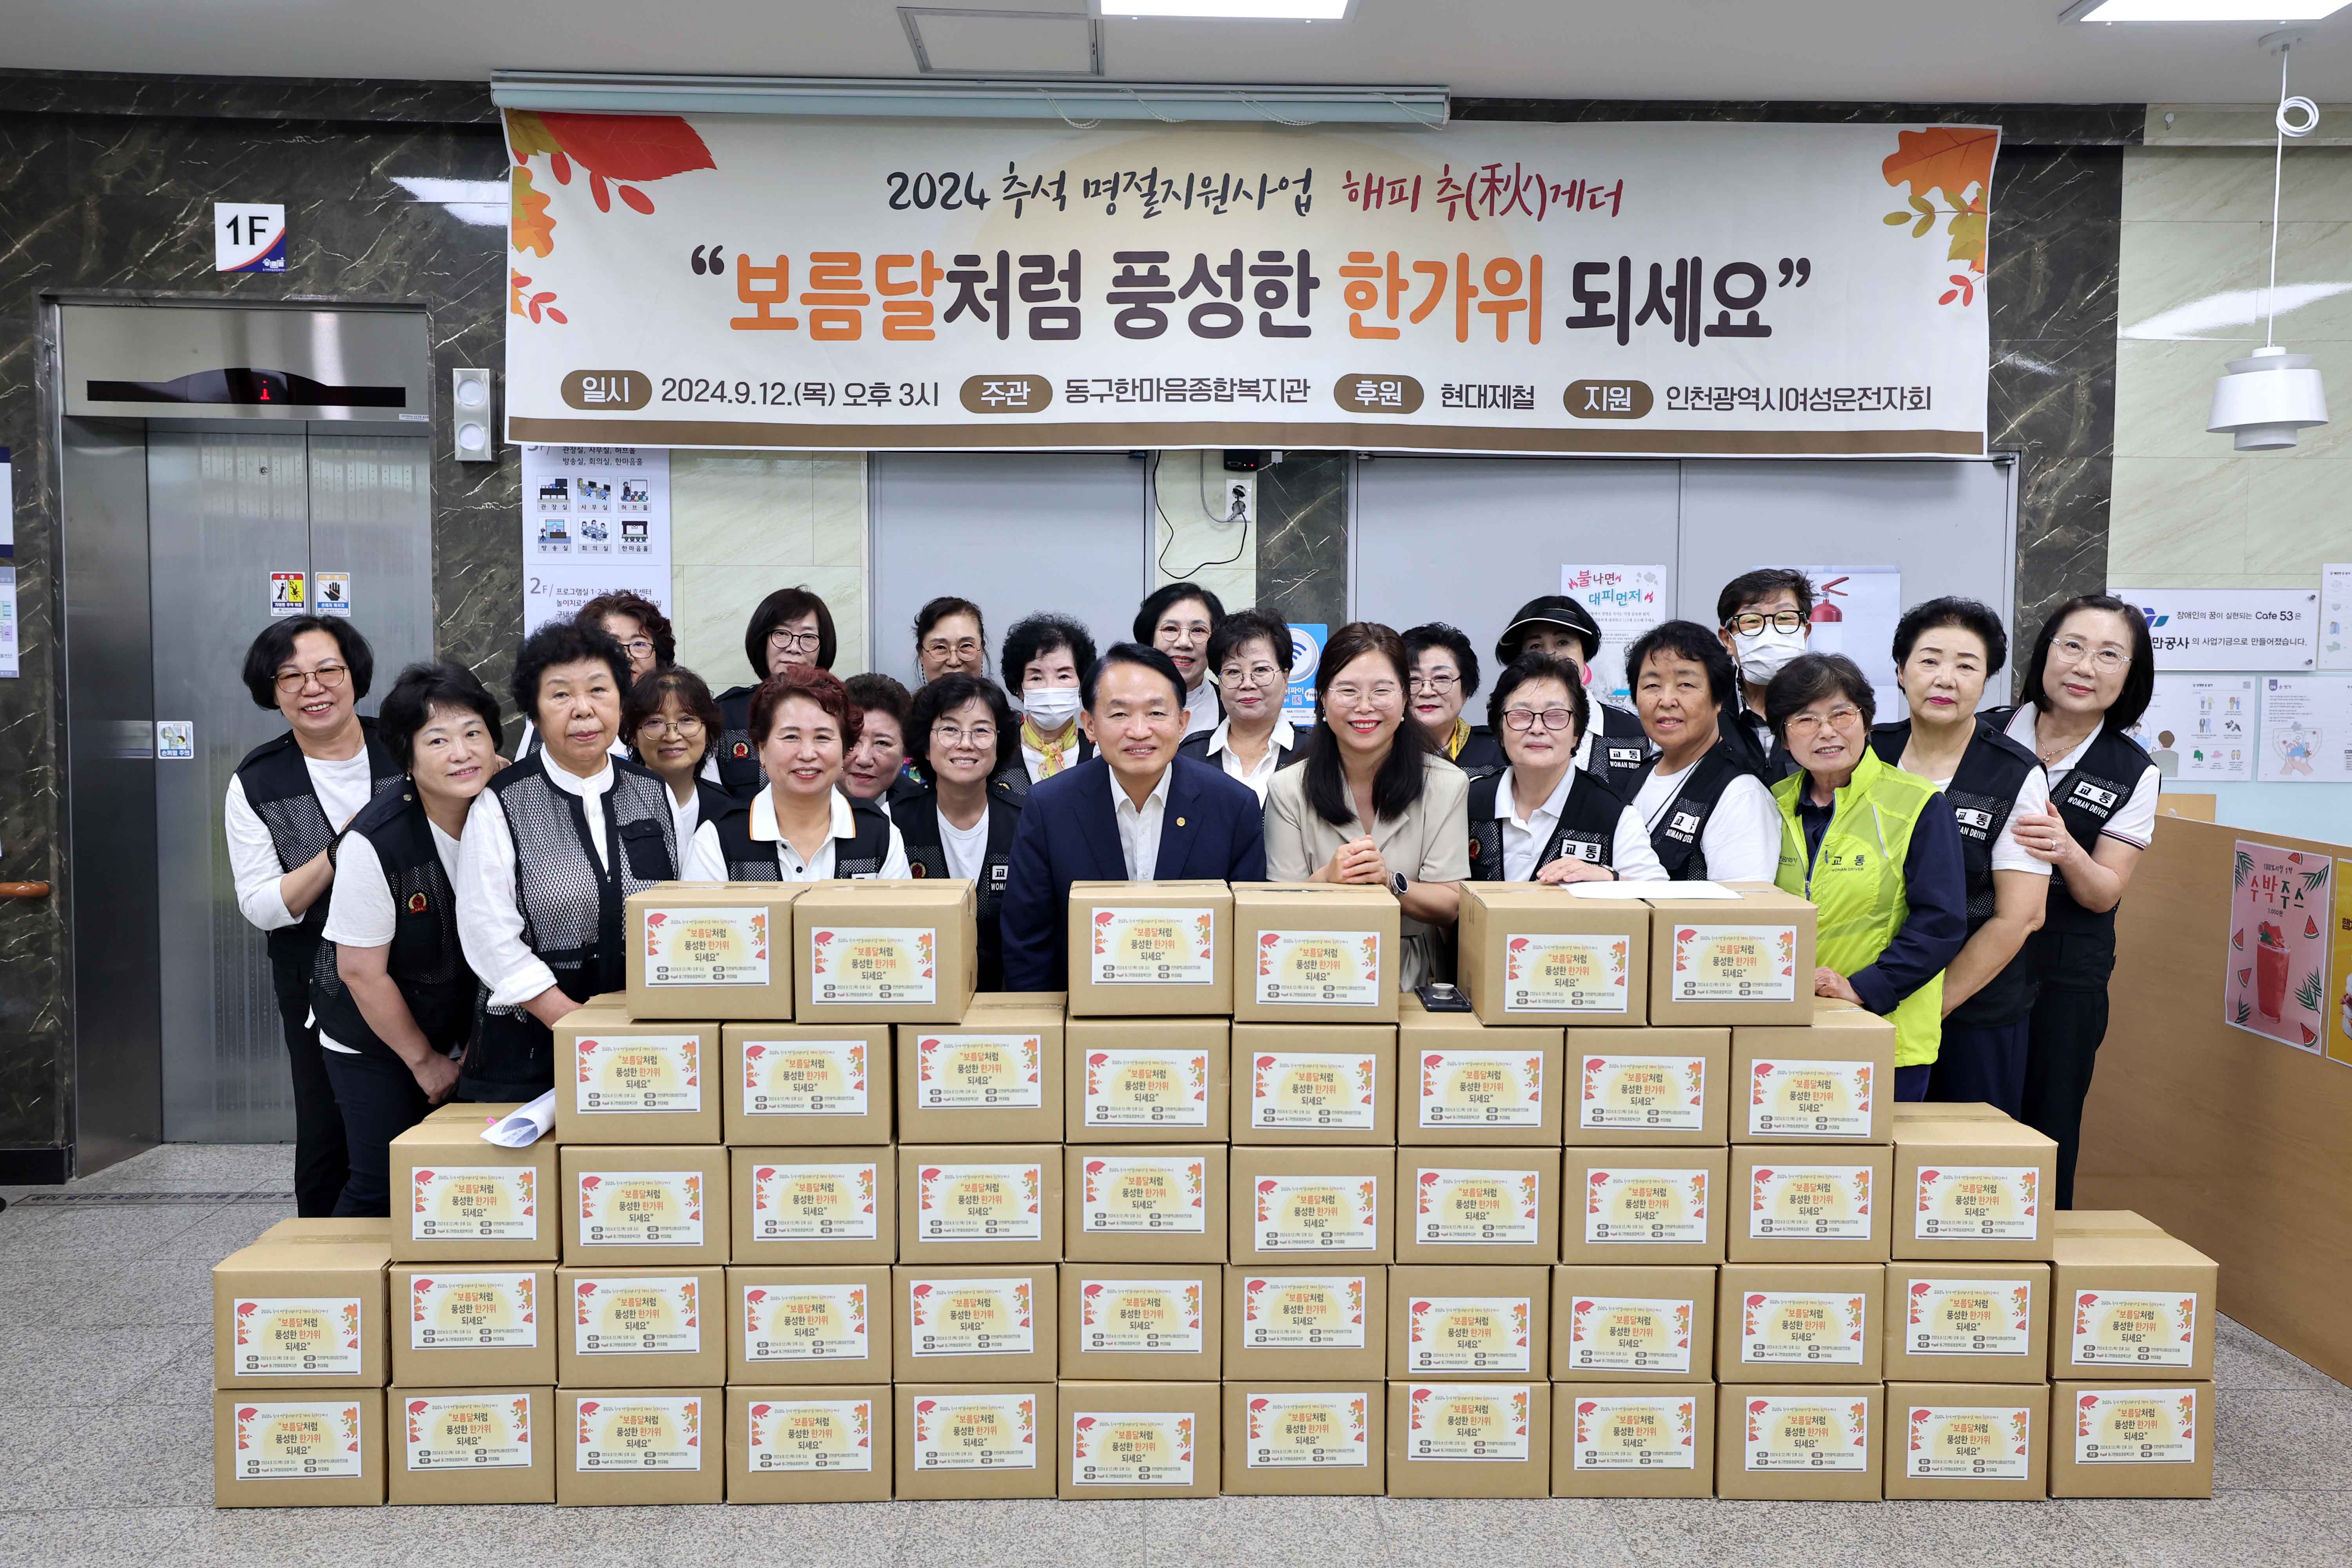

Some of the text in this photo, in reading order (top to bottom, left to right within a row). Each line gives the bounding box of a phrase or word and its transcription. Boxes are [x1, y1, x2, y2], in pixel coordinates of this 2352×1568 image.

[887, 161, 1623, 221] 2024 추석 명절지원사업 해피 추(秋)게더
[226, 215, 269, 245] 1F
[691, 245, 1811, 347] “보름달처럼 풍성한 한가위 되세요”
[583, 377, 1931, 411] 일시 2024.9.12.(목) 오후 3시 주관 동구한마음종합복지관 후원 현대제철 지원 인천광역시여성운전자회
[1577, 570, 1615, 587] 불나면
[1589, 589, 1641, 606] 대피먼저
[2067, 796, 2109, 819] WOMAN DRIVER
[1969, 828, 1987, 840] DRIVER
[684, 940, 730, 950] 풍성한 한가위
[1713, 956, 1757, 966] 풍성한 한가위
[616, 1067, 661, 1077] 풍성한 한가위
[1789, 1091, 1834, 1102] 풍성한 한가위
[452, 1196, 497, 1206] 풍성한 한가위
[1456, 1200, 1500, 1209] 풍성한 한가위
[1956, 1196, 2000, 1206] 풍성한 한가위
[1283, 1305, 1327, 1315] 풍성한 한가위
[2112, 1321, 2156, 1332] 풍성한 한가위
[275, 1329, 321, 1339] 풍성한 한가위
[446, 1425, 492, 1435] 풍성한 한가위
[1947, 1435, 1991, 1445] 풍성한 한가위
